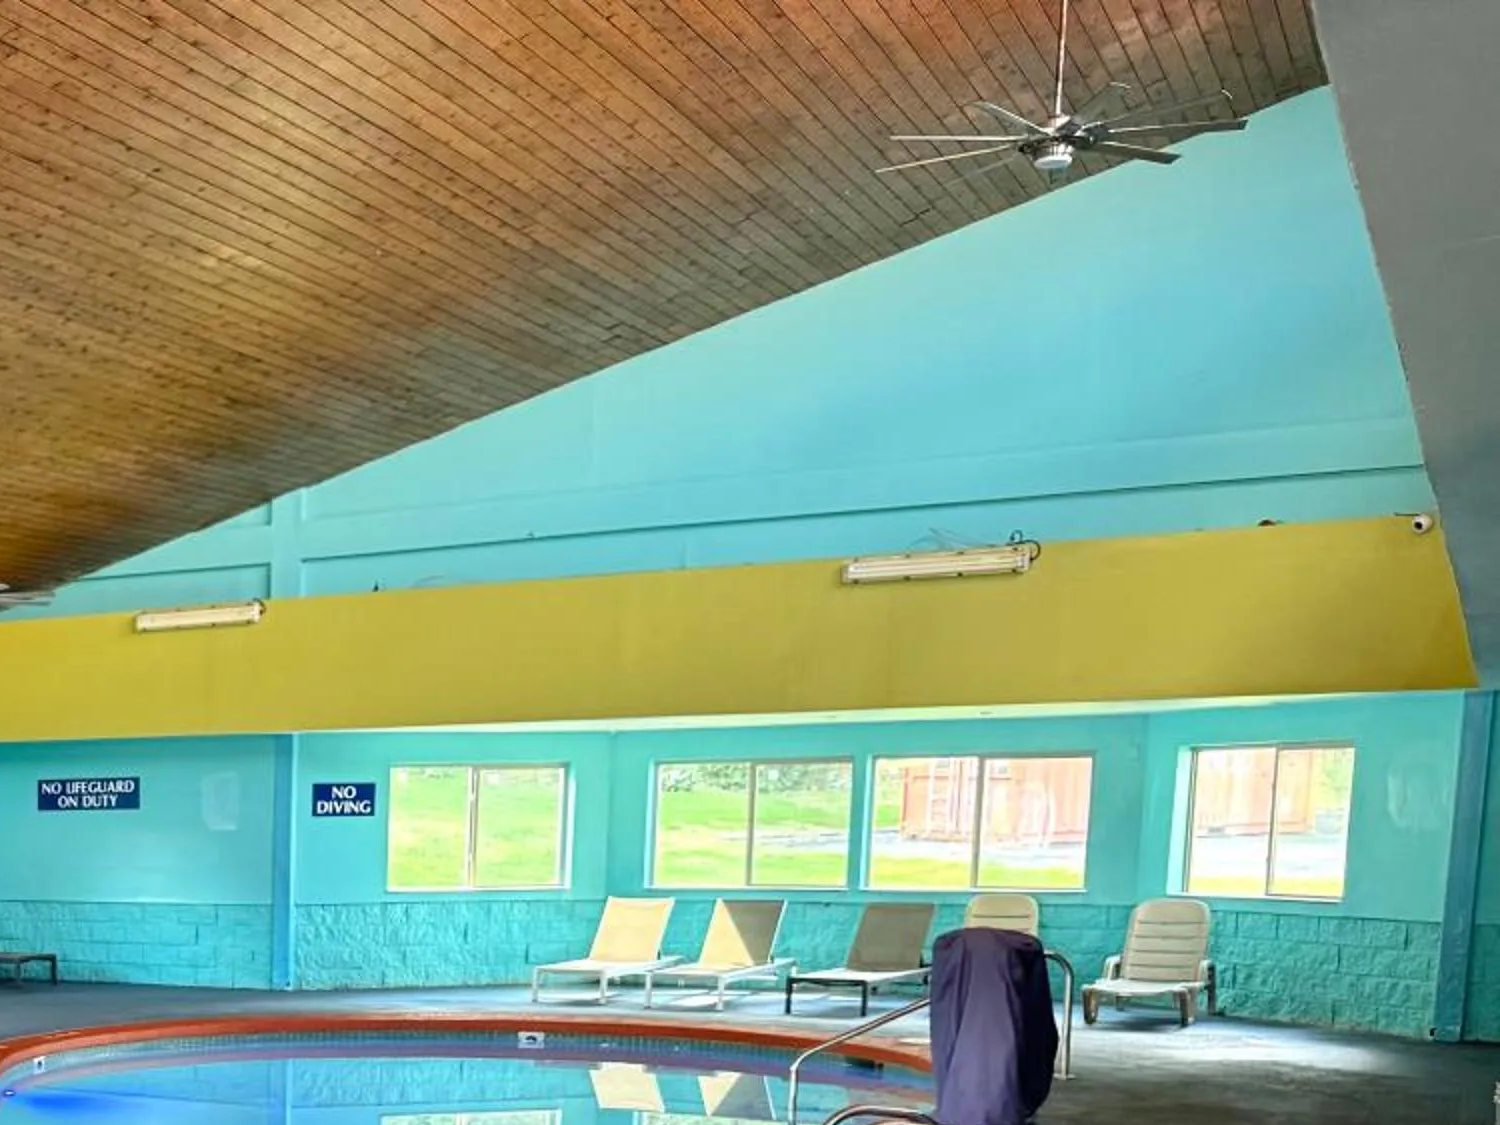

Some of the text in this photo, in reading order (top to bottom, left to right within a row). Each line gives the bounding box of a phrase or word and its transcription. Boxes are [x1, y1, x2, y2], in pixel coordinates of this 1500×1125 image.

[41, 779, 135, 795] NO LIFEGUARD
[331, 785, 357, 799] NO
[57, 794, 118, 808] ON DUTY
[316, 799, 372, 814] DIVING
